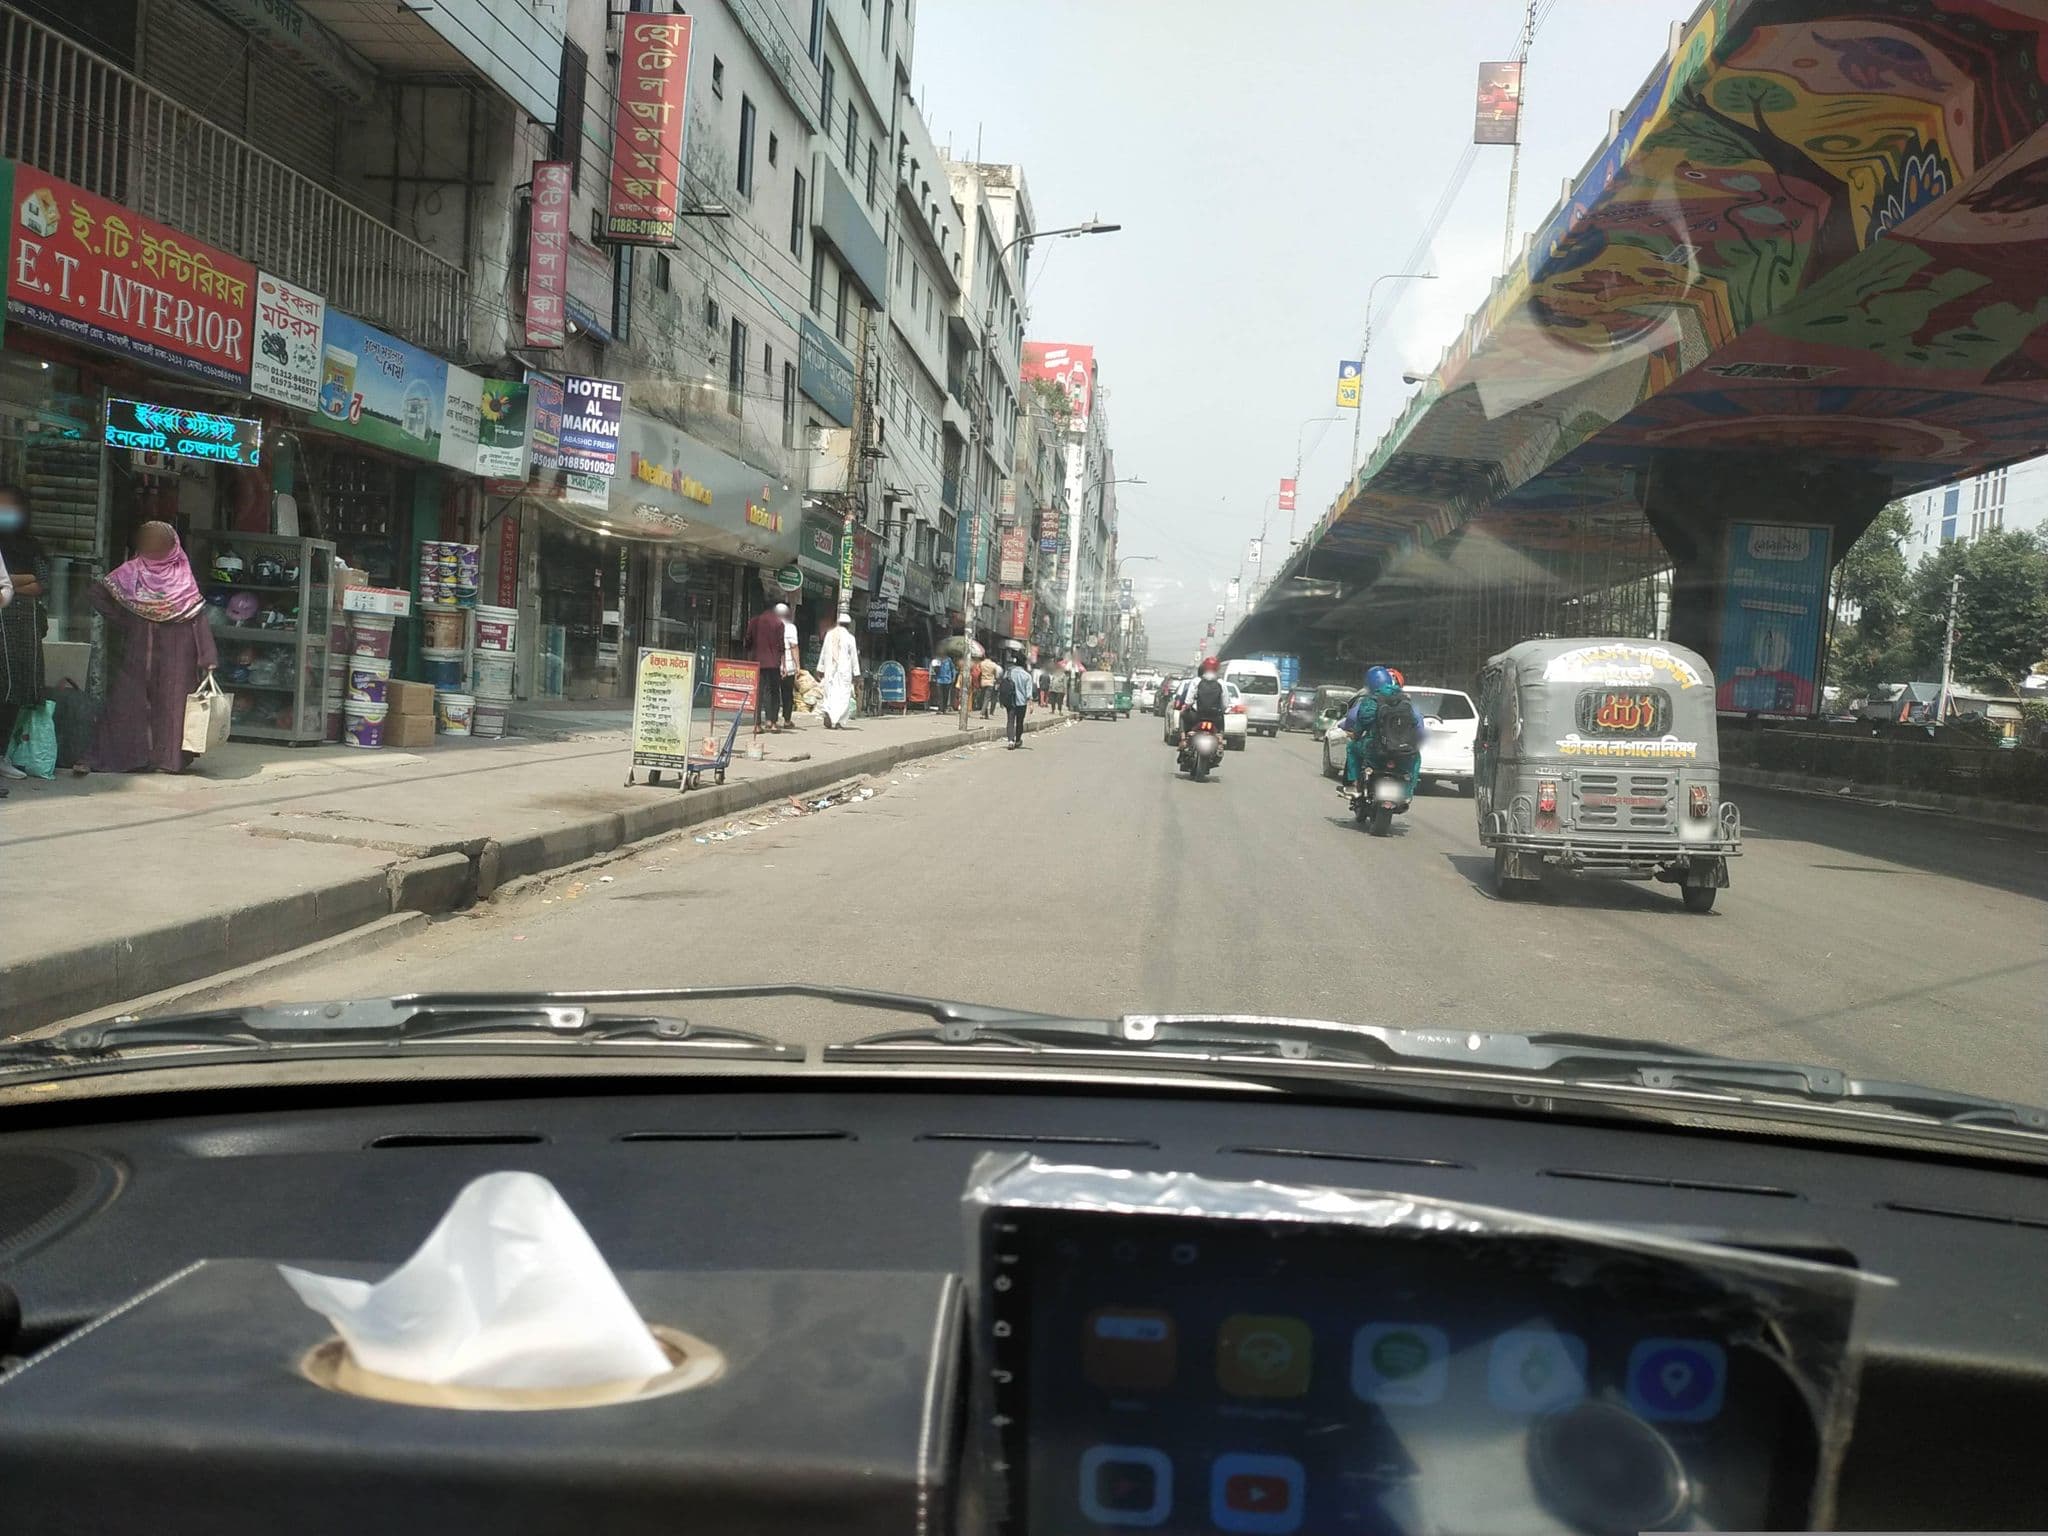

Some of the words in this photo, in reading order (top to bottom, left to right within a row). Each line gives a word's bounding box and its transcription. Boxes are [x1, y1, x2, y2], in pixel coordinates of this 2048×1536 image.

[634, 24, 684, 98] হোটেল
[629, 100, 674, 148] আল
[536, 165, 569, 228] হোটেল
[610, 217, 673, 237] 01885-010928
[16, 238, 87, 306] E.T.
[97, 267, 244, 363] INTERIOR
[279, 284, 320, 318] ইকরা
[567, 378, 622, 401] HOTEL
[585, 399, 603, 417] AL
[562, 414, 620, 437] MAKKAH
[563, 435, 592, 447] ABASHIC
[593, 439, 615, 450] FRESH
[558, 454, 616, 475] 01885010928
[1597, 694, 1654, 729] الله
